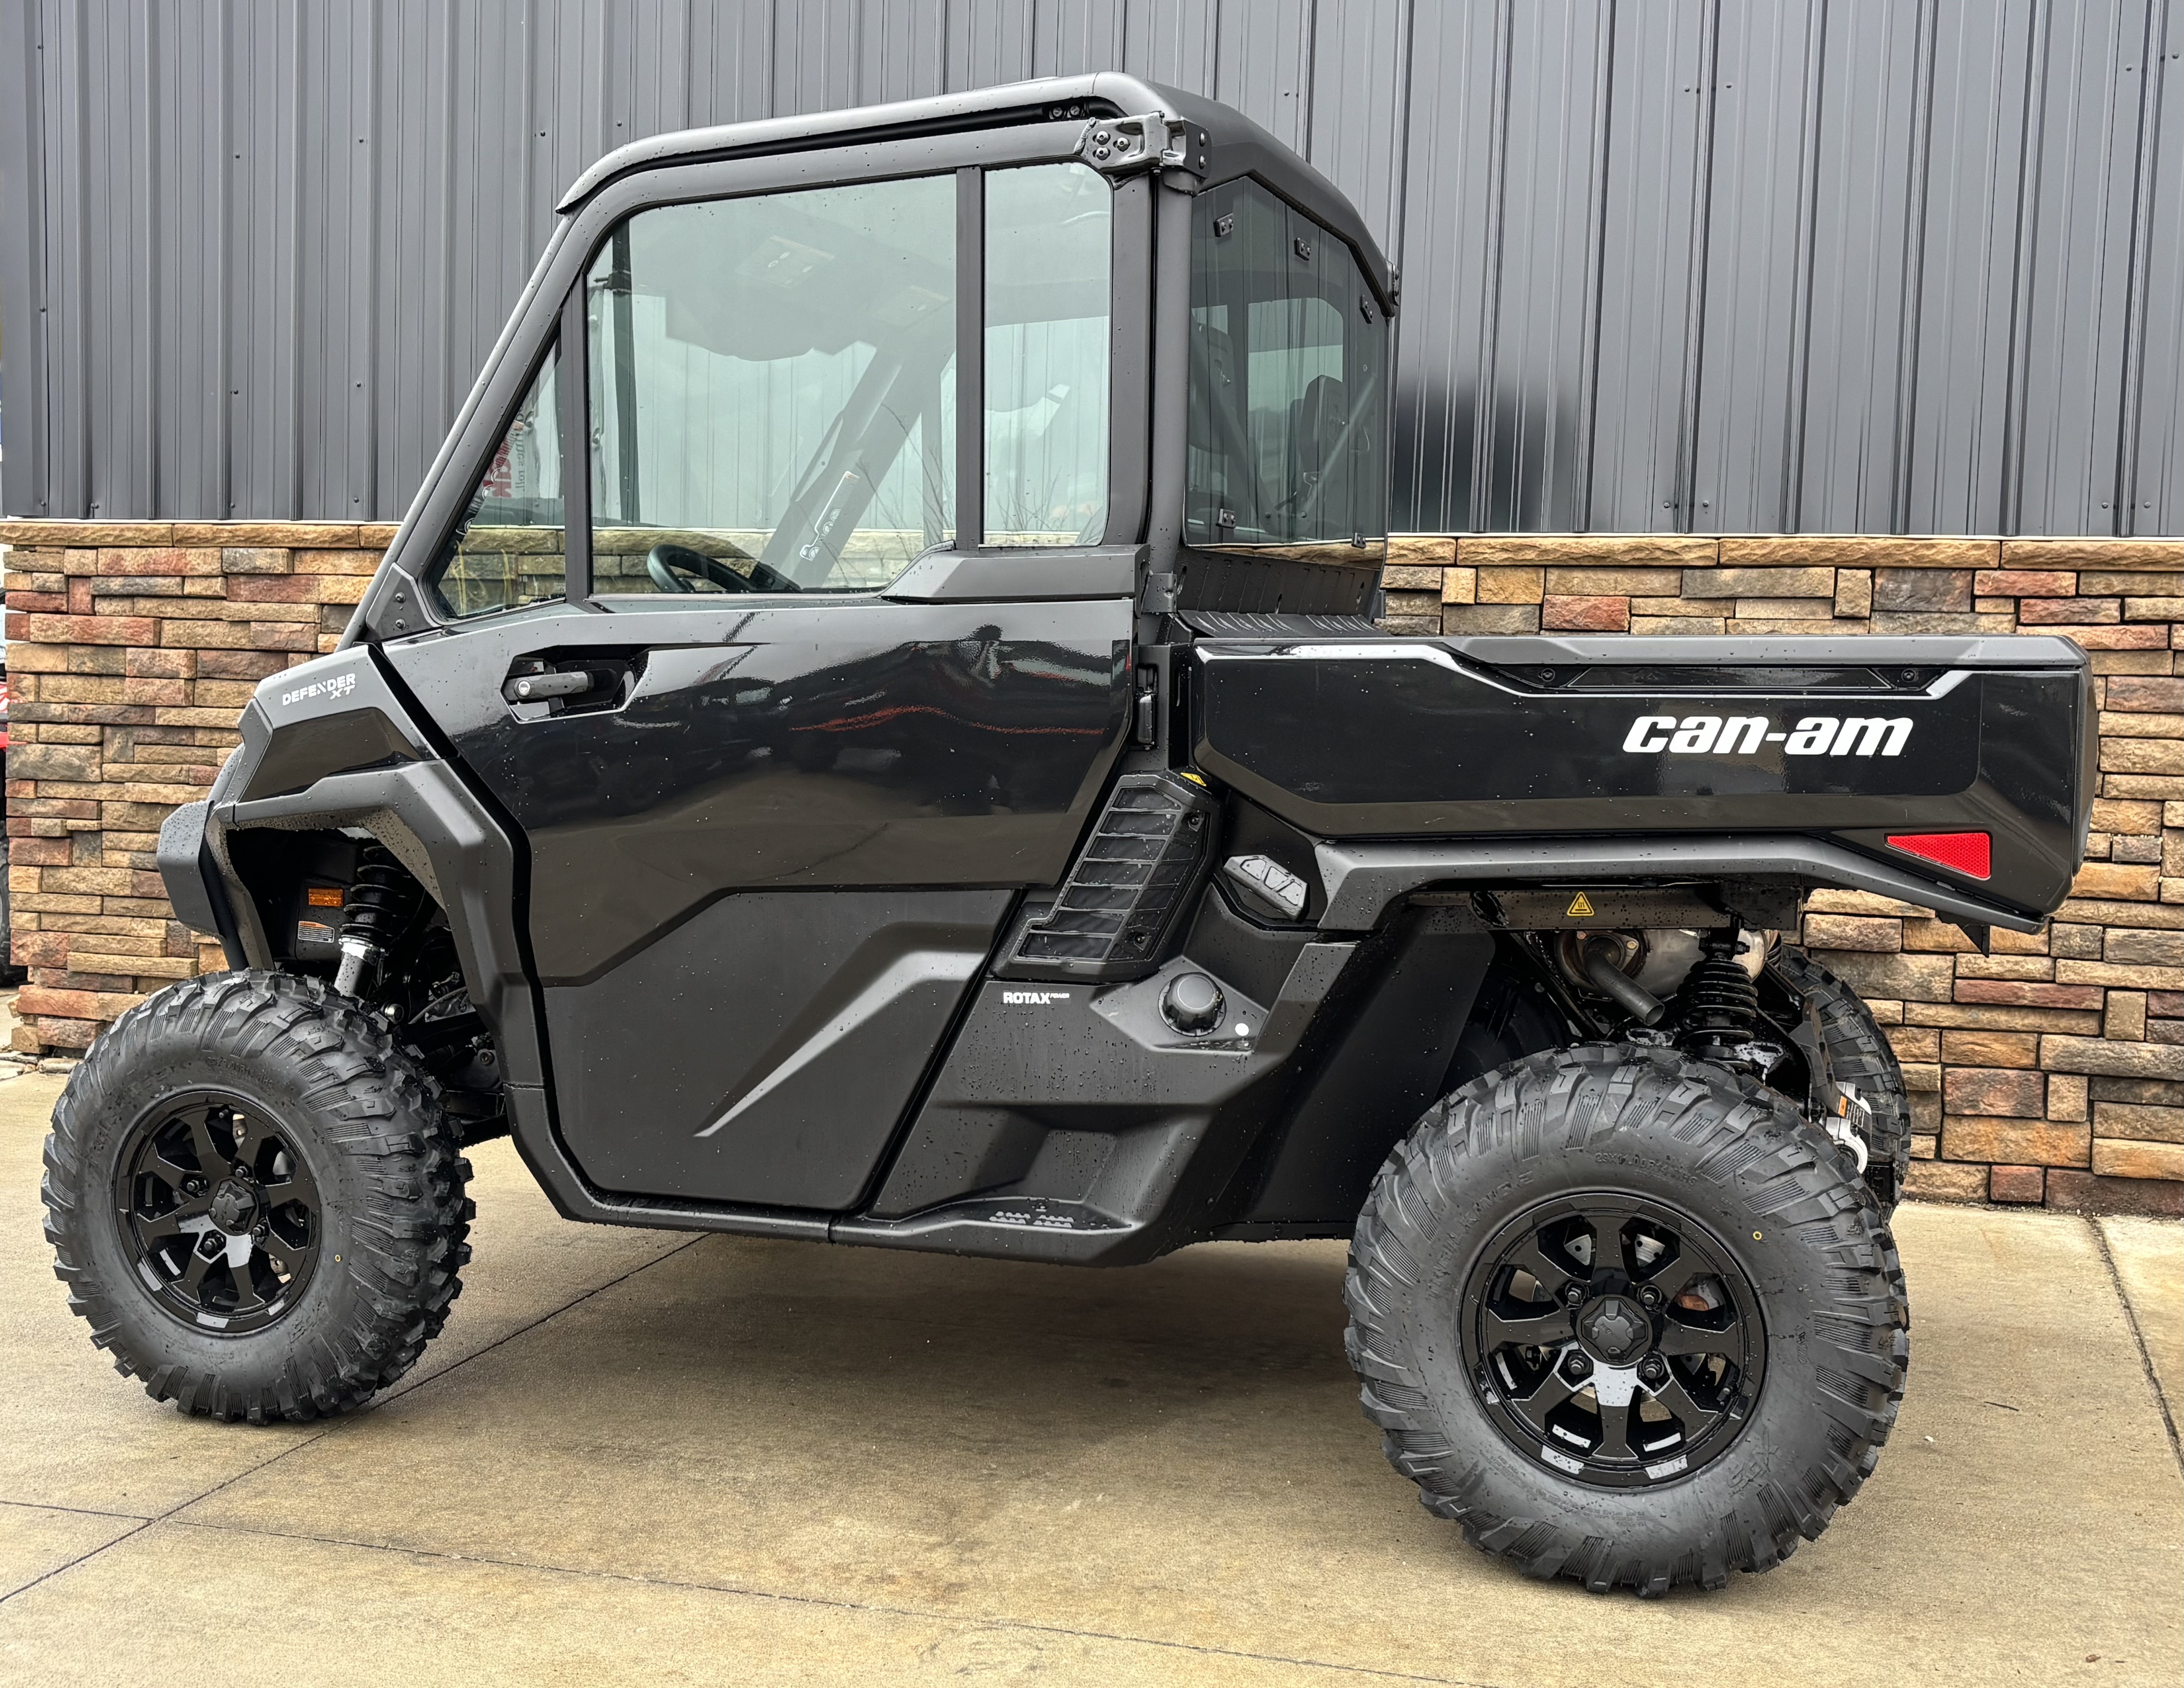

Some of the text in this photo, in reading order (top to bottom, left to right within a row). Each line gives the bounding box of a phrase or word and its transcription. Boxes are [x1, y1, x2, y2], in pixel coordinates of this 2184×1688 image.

[282, 673, 356, 706] DEFENDER
[330, 685, 355, 700] XT
[1623, 716, 1913, 756] can-am
[1003, 992, 1050, 1004] ROTAX
